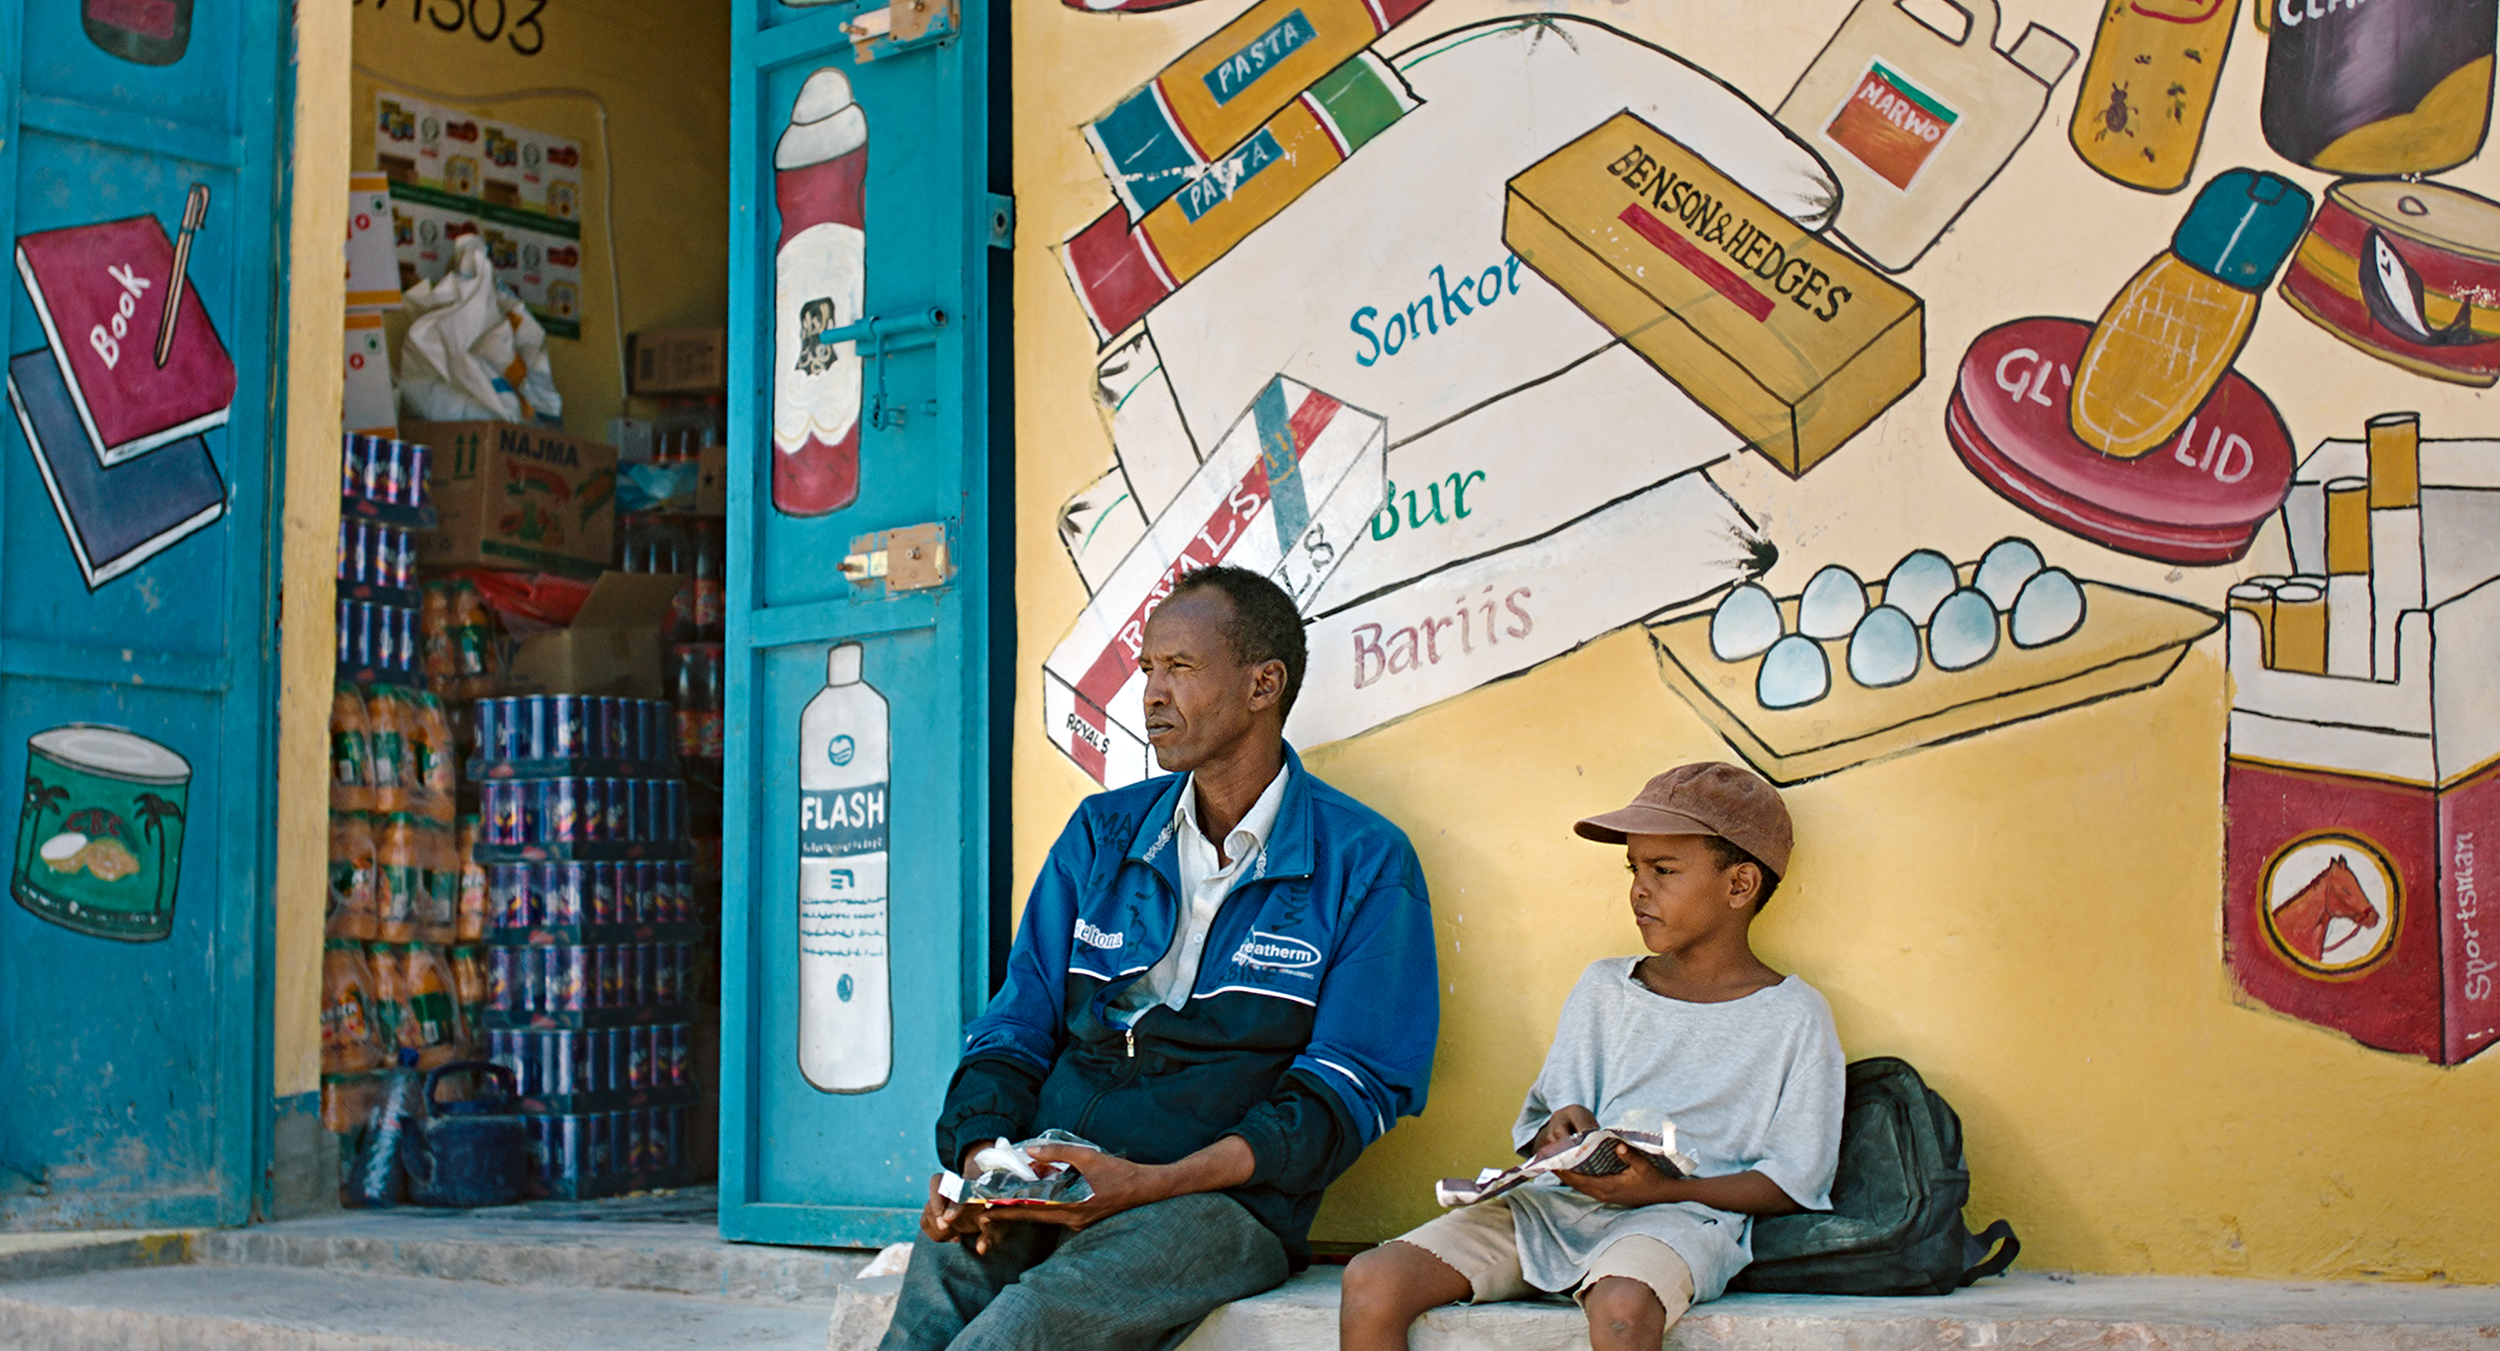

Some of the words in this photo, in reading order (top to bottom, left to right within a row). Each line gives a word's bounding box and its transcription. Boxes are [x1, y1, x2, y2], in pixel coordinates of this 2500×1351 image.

[1217, 22, 1300, 93] PASTA
[1858, 81, 1940, 143] MARWO
[90, 263, 151, 371] Book
[1350, 254, 1523, 367] Sonkor
[500, 429, 581, 468] NAJMA
[1351, 584, 1533, 690] Bariis
[801, 789, 885, 832] FLASH
[1239, 940, 1313, 964] reatherm
[2454, 832, 2498, 1001] Sportsman
